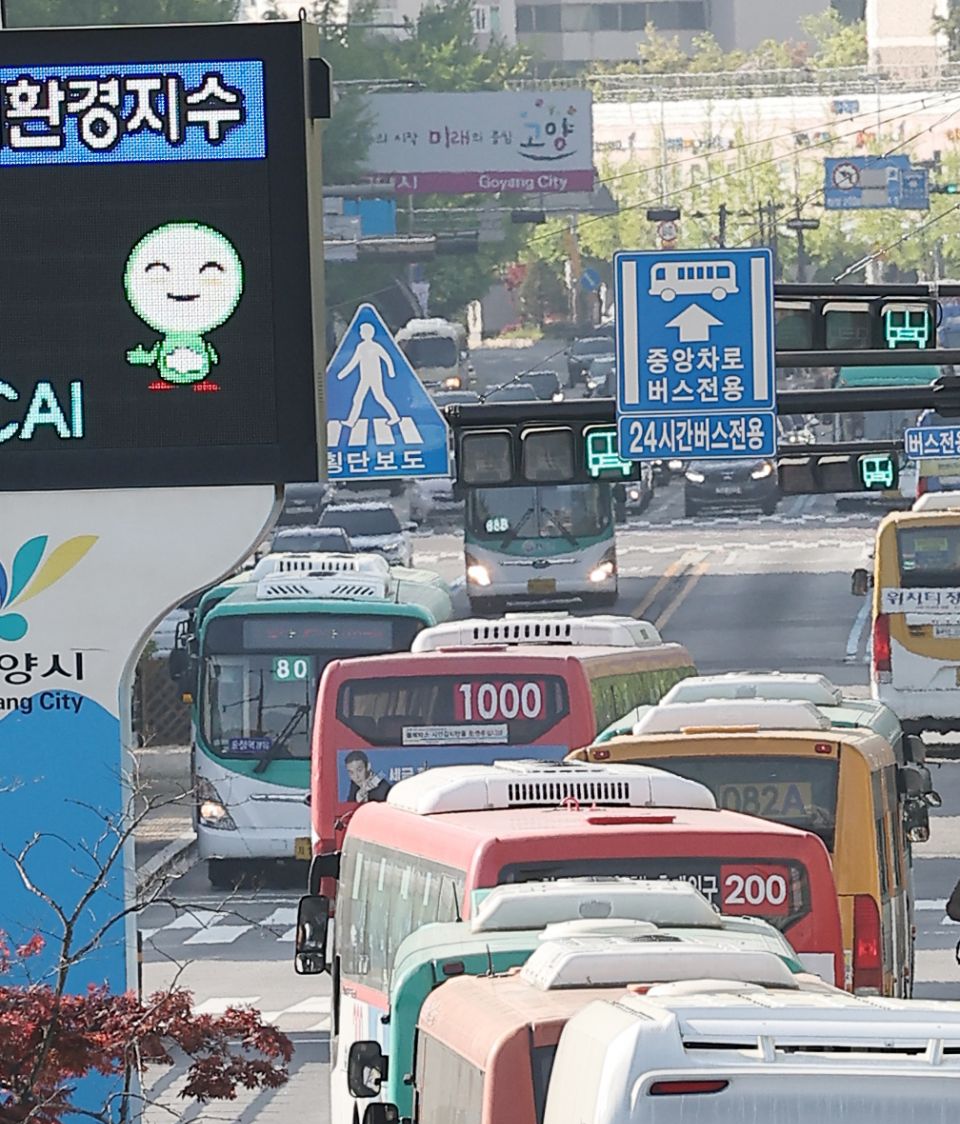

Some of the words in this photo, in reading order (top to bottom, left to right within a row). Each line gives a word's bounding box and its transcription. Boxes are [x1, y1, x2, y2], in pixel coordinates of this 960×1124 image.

[5, 77, 241, 149] 환경지수
[429, 125, 483, 149] 미래의
[519, 117, 575, 151] 고양
[478, 173, 530, 191] Goyang
[537, 173, 569, 190] City
[646, 345, 744, 375] 중앙차로
[648, 375, 744, 404] 버스전용
[629, 416, 765, 454] 24시간버스전용
[0, 652, 84, 685] 양시
[276, 659, 307, 679] 80
[40, 691, 84, 715] City
[458, 682, 542, 722] 1000
[725, 874, 787, 906] 200
